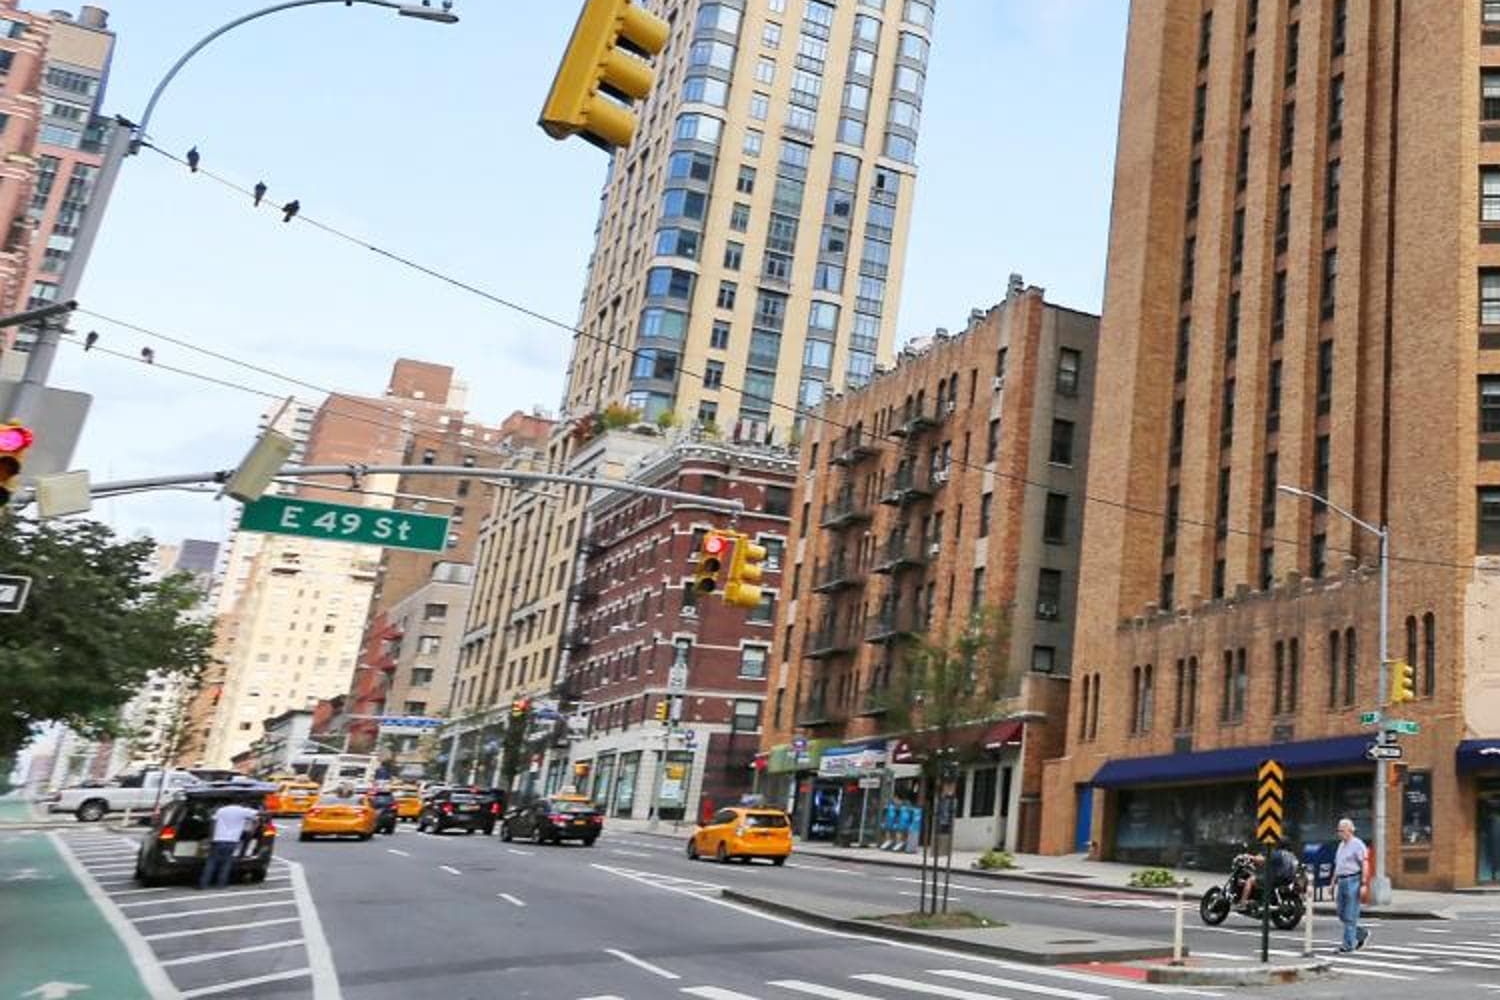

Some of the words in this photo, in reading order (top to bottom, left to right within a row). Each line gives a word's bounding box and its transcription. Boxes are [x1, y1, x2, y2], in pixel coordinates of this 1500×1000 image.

[279, 505, 304, 529] E
[312, 511, 362, 535] 49
[372, 517, 411, 541] St
